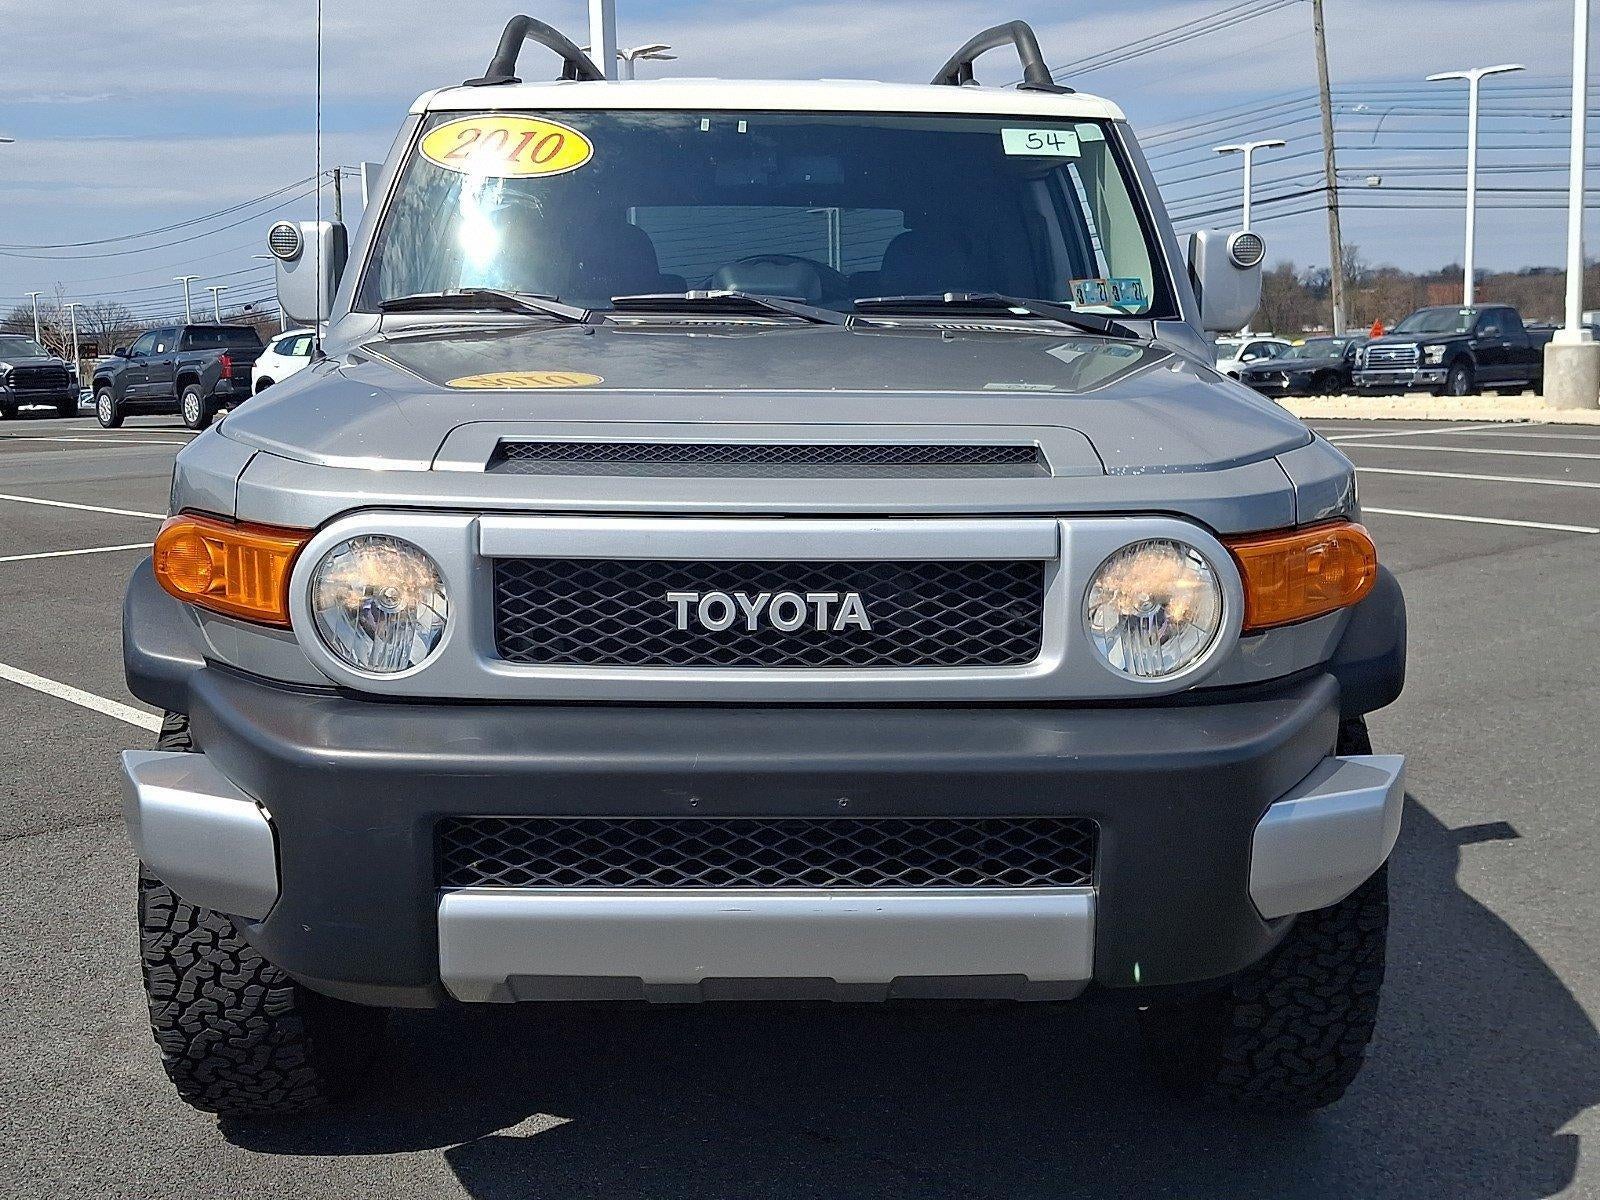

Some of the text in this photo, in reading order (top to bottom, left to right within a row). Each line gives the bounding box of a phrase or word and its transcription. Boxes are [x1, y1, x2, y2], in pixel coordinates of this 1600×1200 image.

[443, 127, 565, 164] 2010
[1025, 132, 1066, 152] 54
[666, 591, 873, 632] TOYOTA
